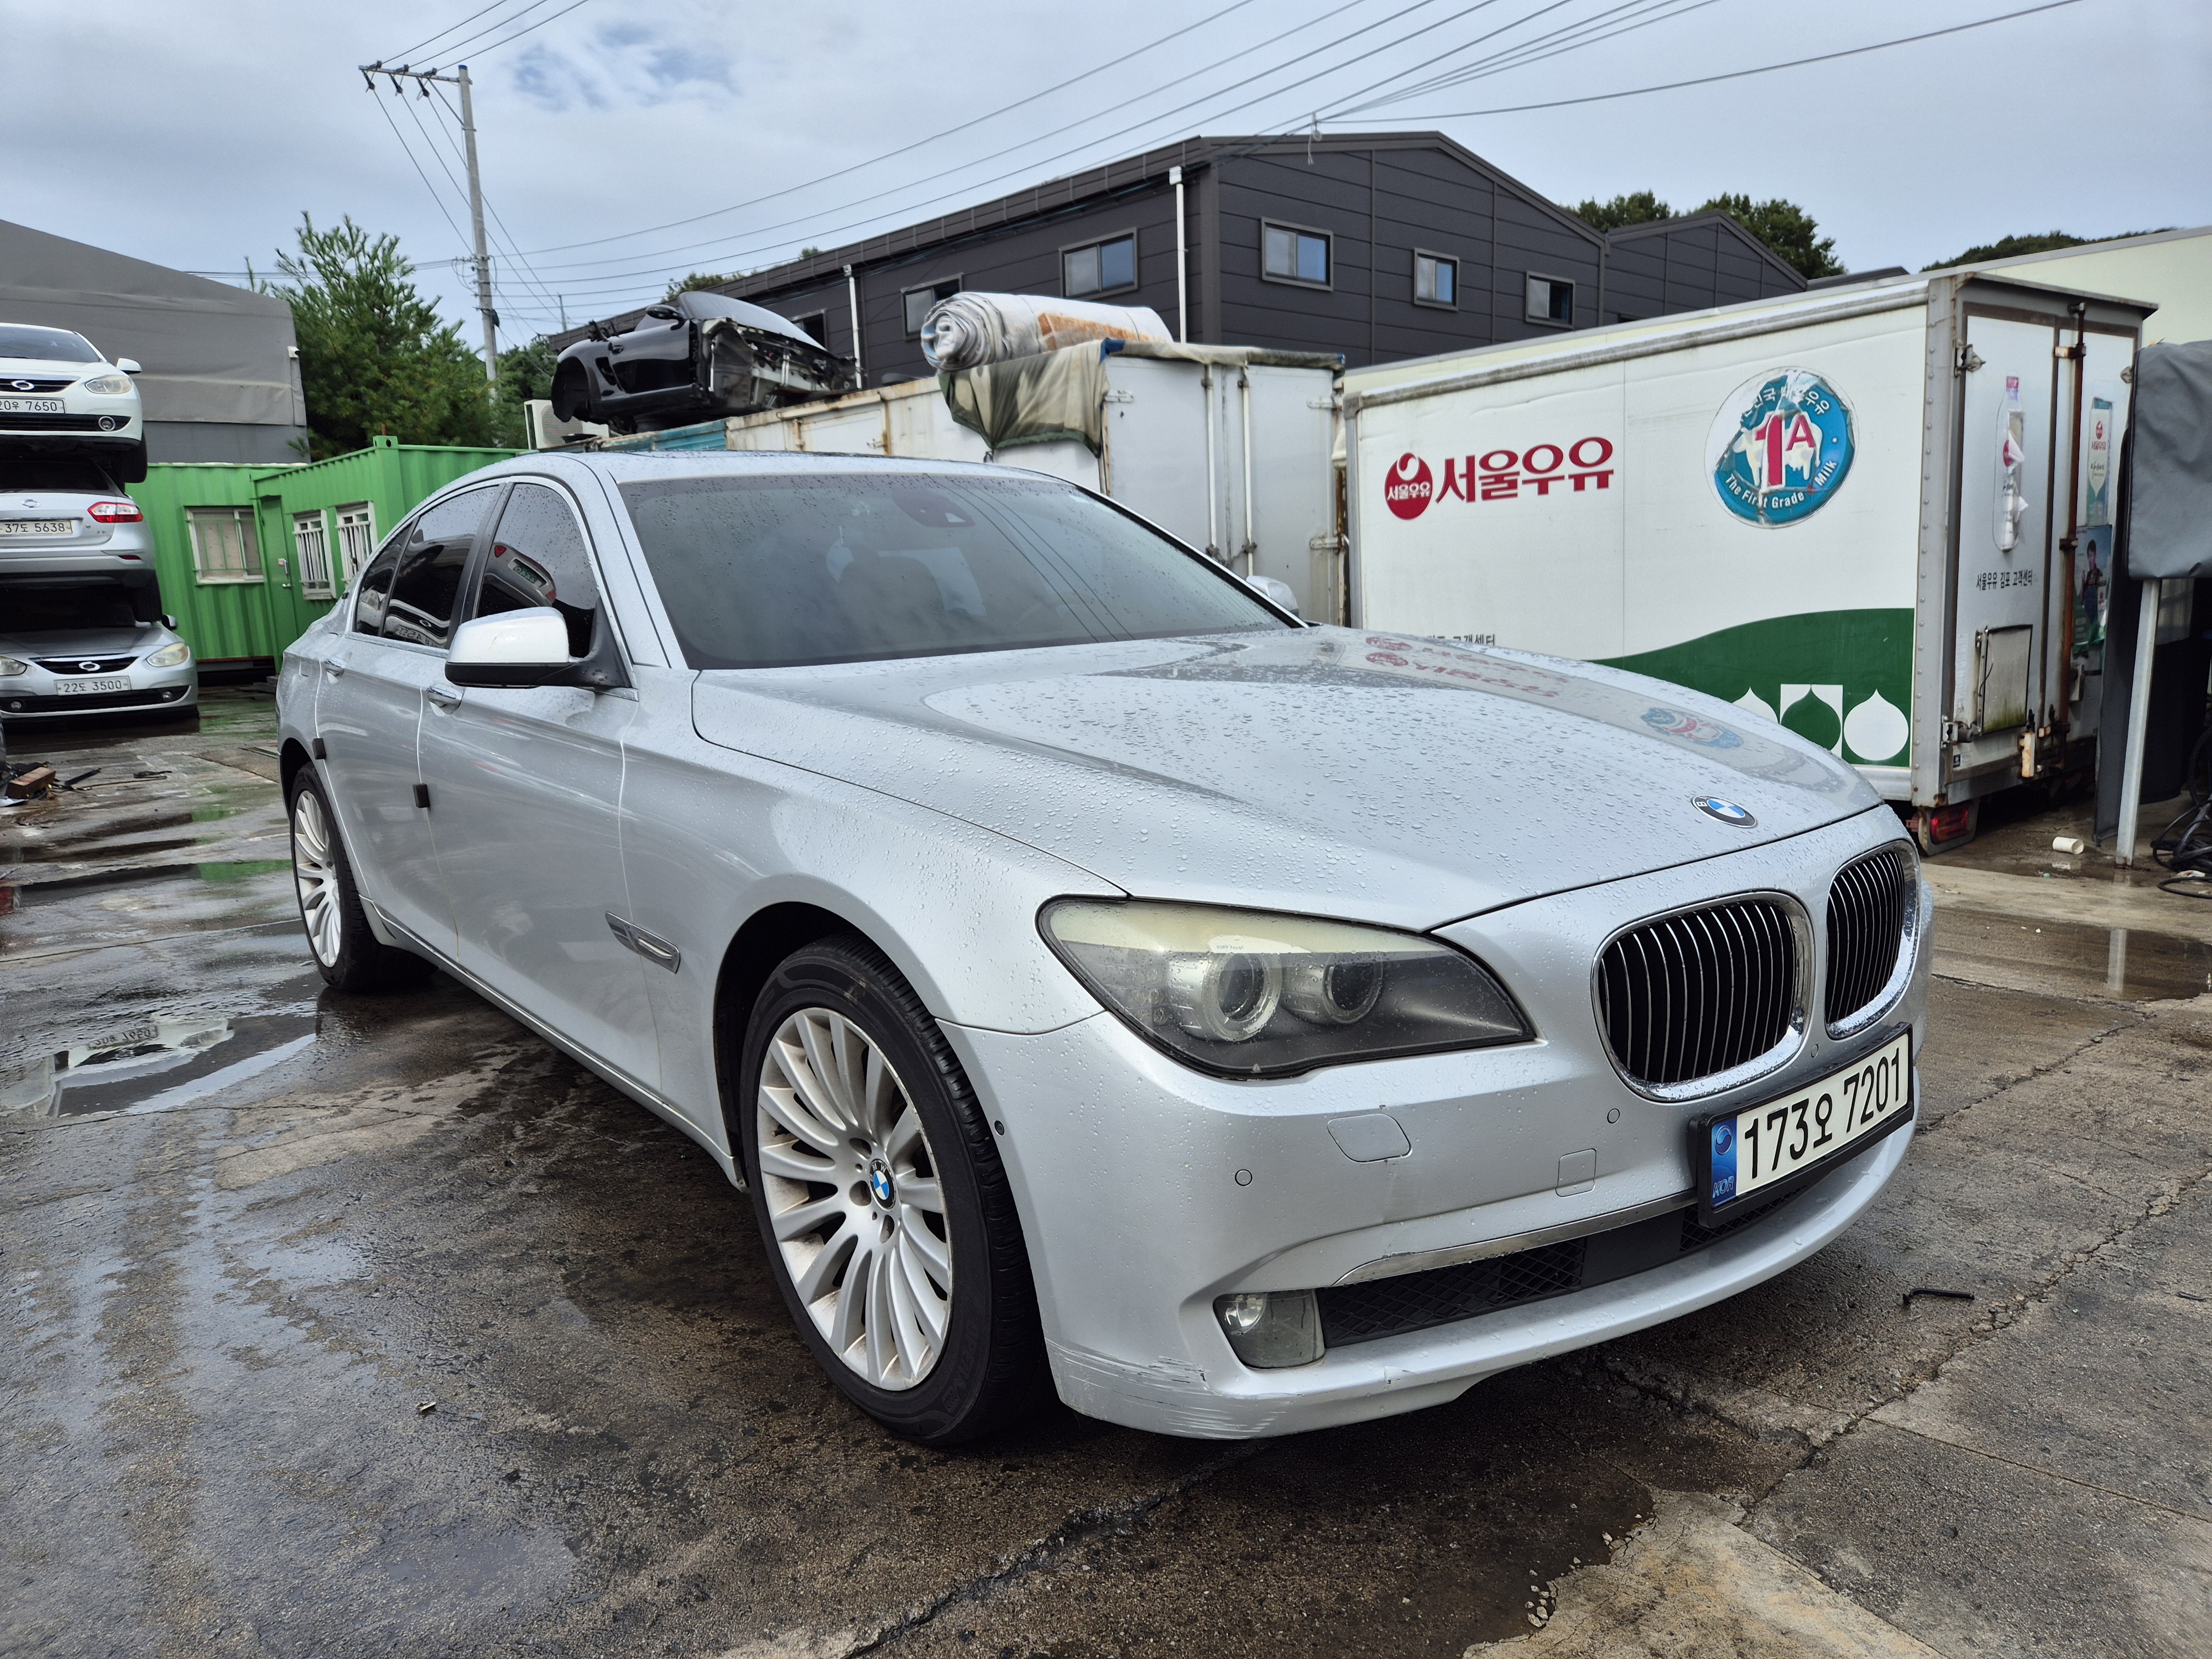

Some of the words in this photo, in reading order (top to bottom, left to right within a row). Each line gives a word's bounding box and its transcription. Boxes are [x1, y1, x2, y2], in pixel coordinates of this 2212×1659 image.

[25, 401, 58, 411] 7650
[1806, 390, 1830, 415] 우유
[1435, 436, 1614, 503] 서울우유
[1387, 481, 1430, 500] 서울우유
[1725, 473, 1741, 495] The
[1741, 489, 1768, 508] Firt
[1772, 492, 1804, 508] Grade
[1814, 460, 1837, 487] Milk
[4, 523, 28, 533] 37도
[34, 523, 65, 532] 5638
[1976, 572, 1997, 591] 서울우유
[2000, 571, 2010, 589] 김포
[2012, 569, 2033, 587] 고객센터
[64, 682, 86, 693] 22도
[92, 680, 122, 691] 3500
[1744, 1093, 1833, 1180] 173오
[1844, 1047, 1900, 1134] 7201
[1713, 1176, 1734, 1198] KOR
